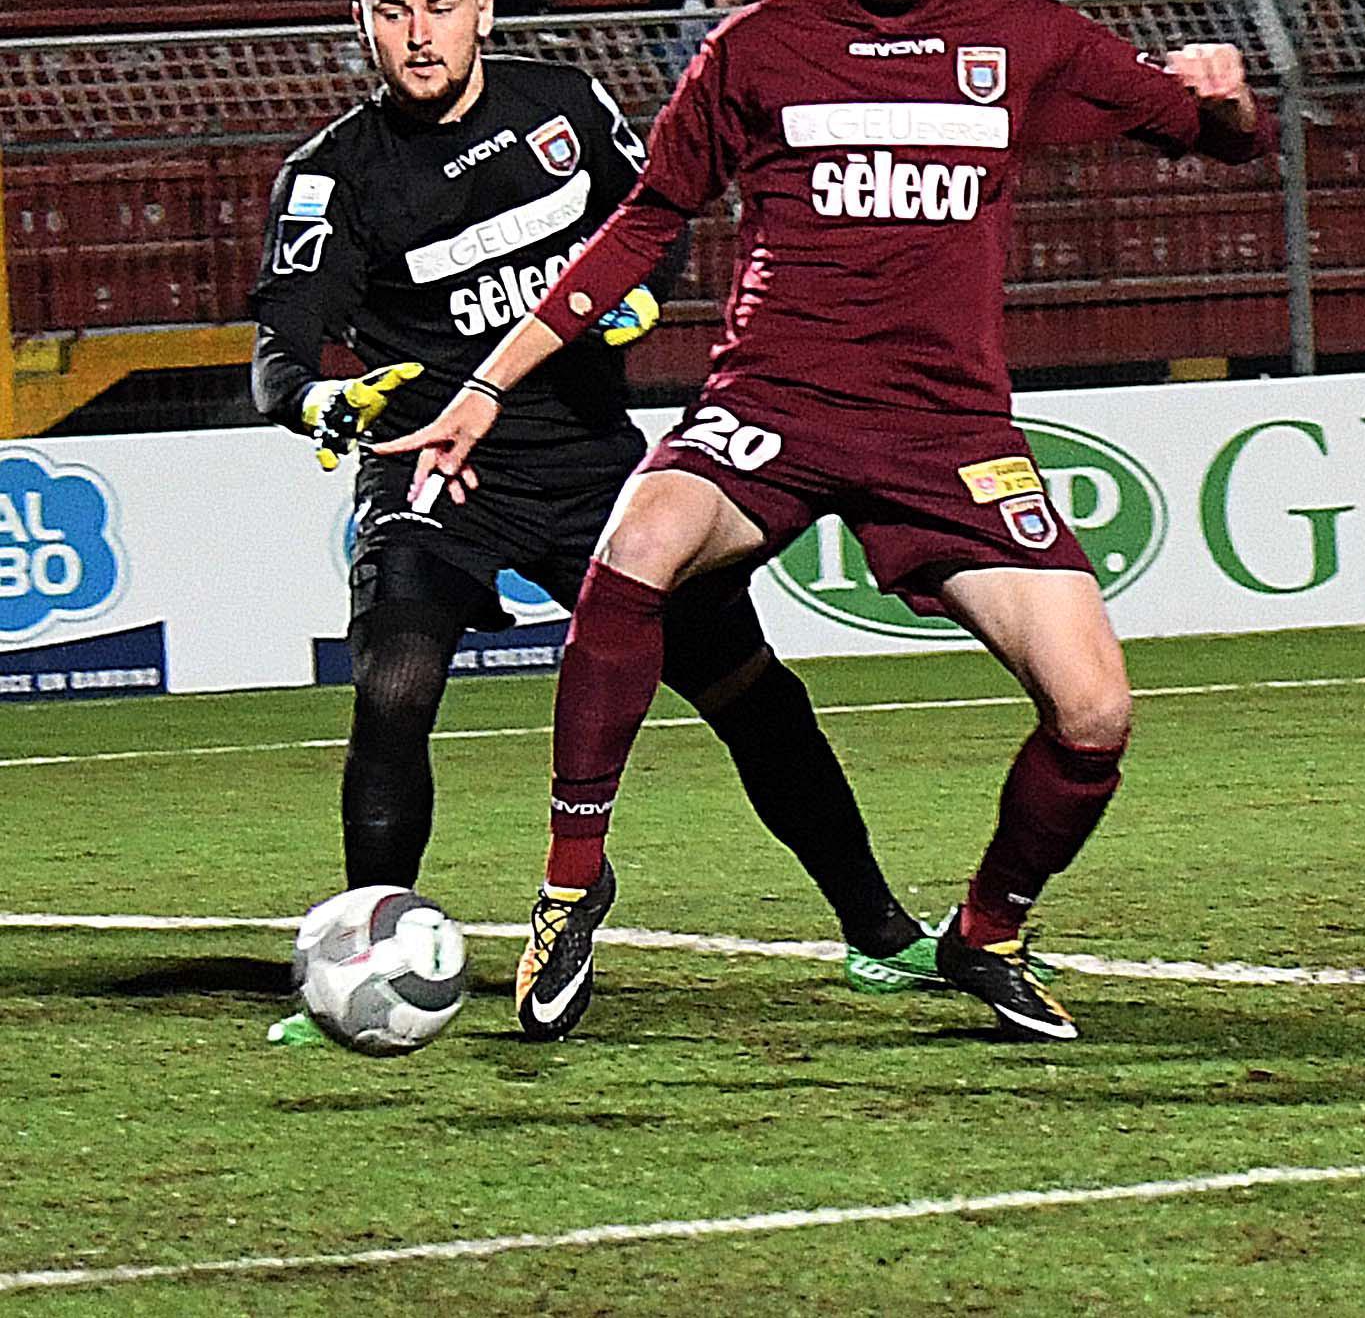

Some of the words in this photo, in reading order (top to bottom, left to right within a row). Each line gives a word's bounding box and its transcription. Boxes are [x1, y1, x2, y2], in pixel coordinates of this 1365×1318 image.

[848, 37, 945, 57] GIVOVA
[443, 129, 519, 179] GIVOVA
[449, 214, 524, 266] GEU
[682, 406, 782, 472] 20
